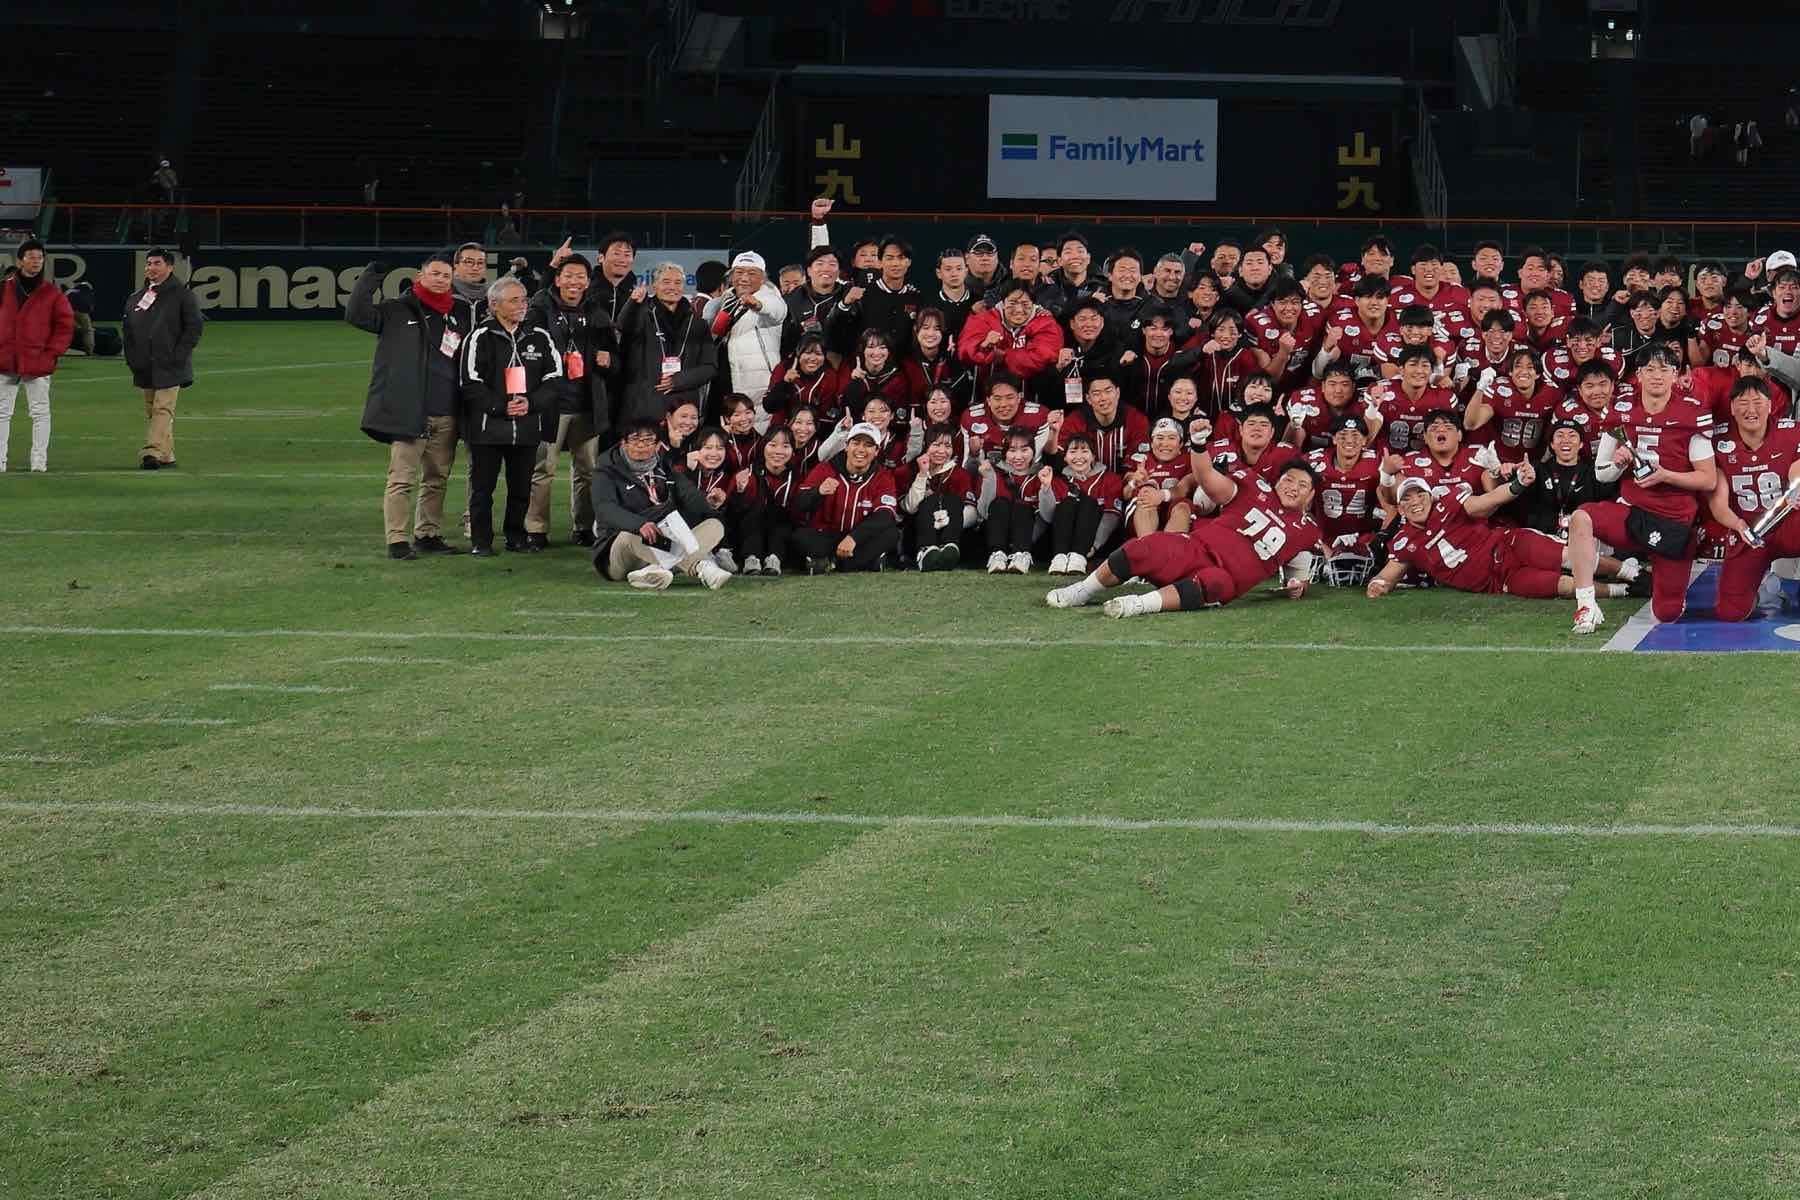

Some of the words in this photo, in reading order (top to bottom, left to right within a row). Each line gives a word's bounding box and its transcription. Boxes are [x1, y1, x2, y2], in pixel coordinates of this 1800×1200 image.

[815, 123, 862, 205] 山九
[1048, 134, 1205, 165] FamilyMart
[1337, 131, 1382, 211] 山九
[1637, 435, 1665, 466] 5
[1321, 488, 1367, 518] 84
[1731, 472, 1784, 512] 58
[1236, 506, 1287, 561] 79
[1438, 537, 1469, 569] 4
[1713, 545, 1726, 558] 11
